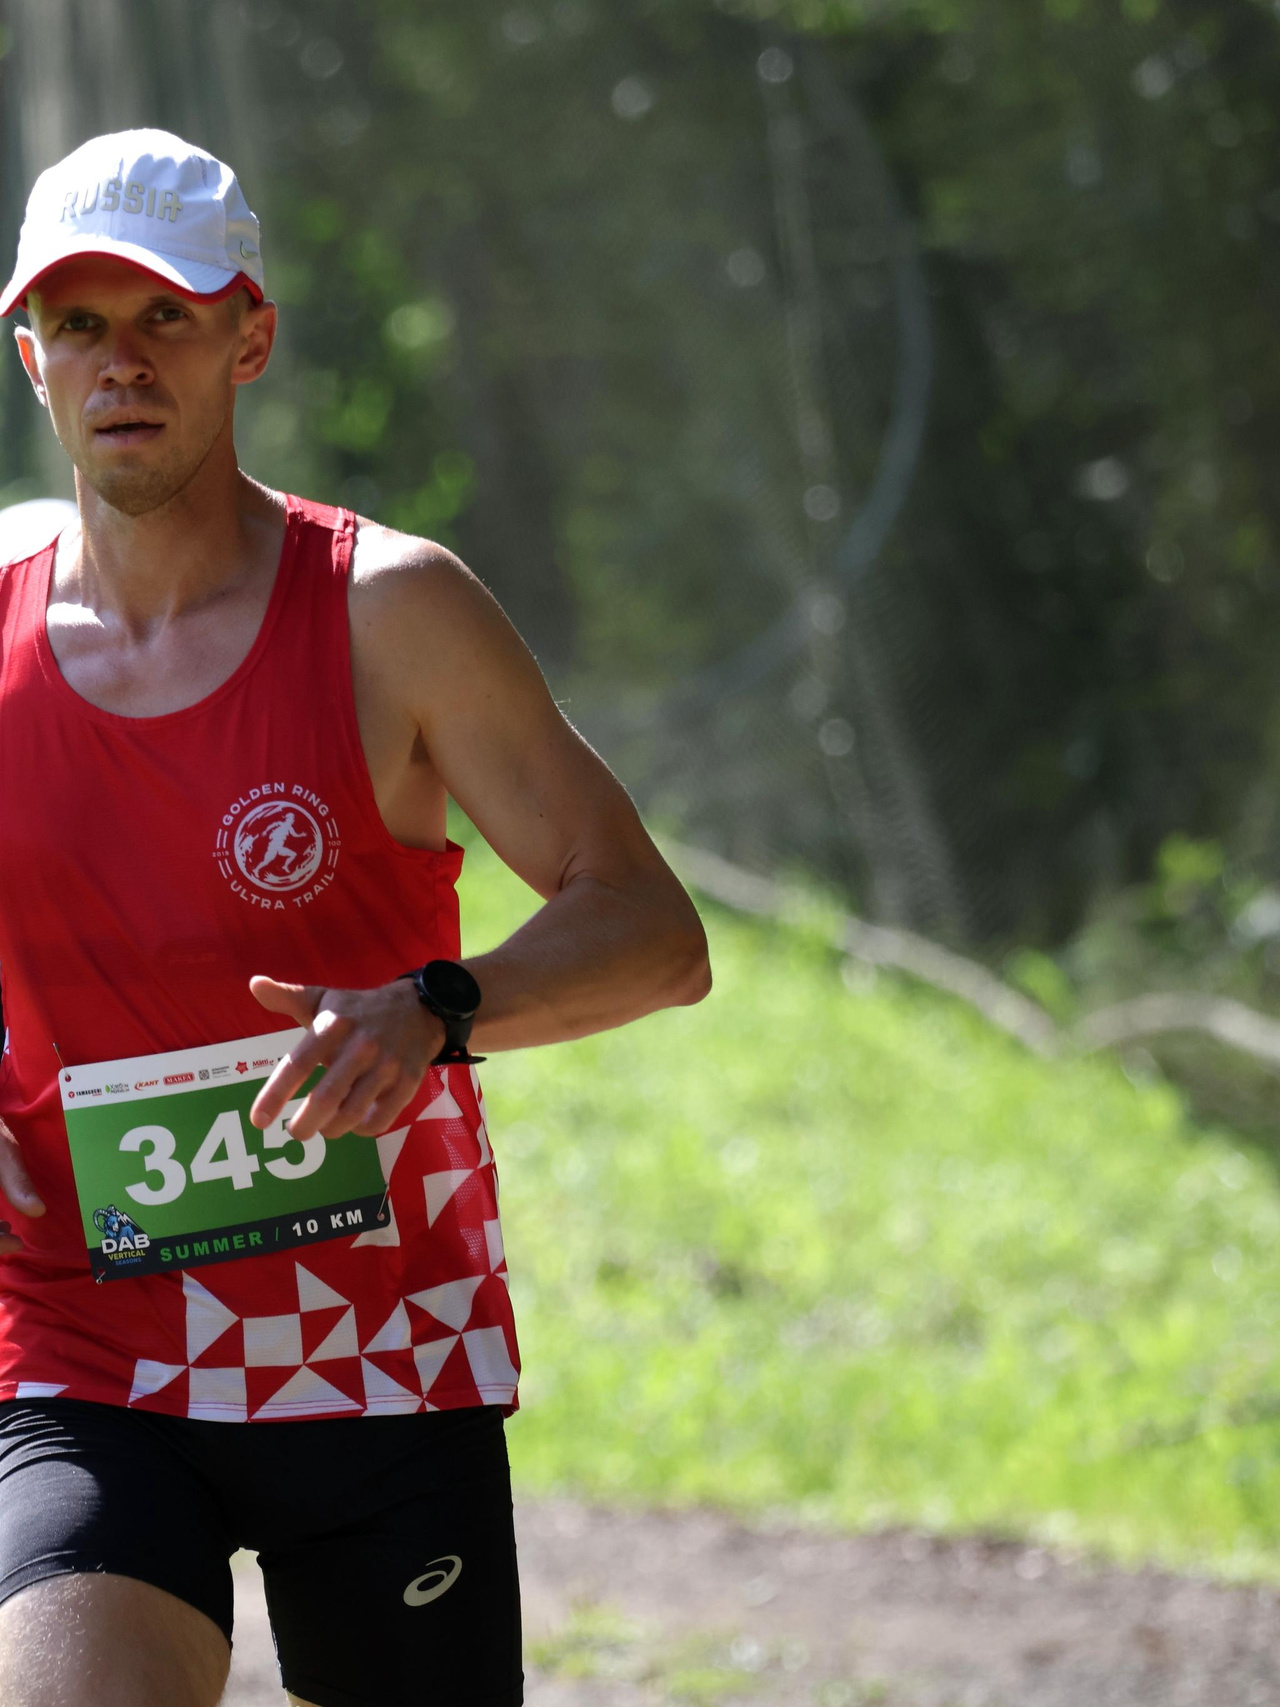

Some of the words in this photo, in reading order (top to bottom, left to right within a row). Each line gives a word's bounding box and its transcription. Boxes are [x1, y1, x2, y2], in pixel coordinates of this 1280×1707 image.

[60, 179, 183, 222] RUSSIA
[223, 783, 285, 826] GOLDEN
[292, 785, 329, 817] RING
[230, 880, 285, 910] ULTRA
[293, 872, 334, 907] TRAIL
[76, 1088, 102, 1096] YAMAGUCHI
[119, 1097, 327, 1206] 345
[101, 1234, 150, 1254] DAB
[160, 1231, 263, 1262] SUMMER
[292, 1219, 319, 1237] 10
[330, 1209, 363, 1229] KM
[108, 1250, 146, 1261] VERTICAL
[115, 1257, 141, 1266] SEASONS
